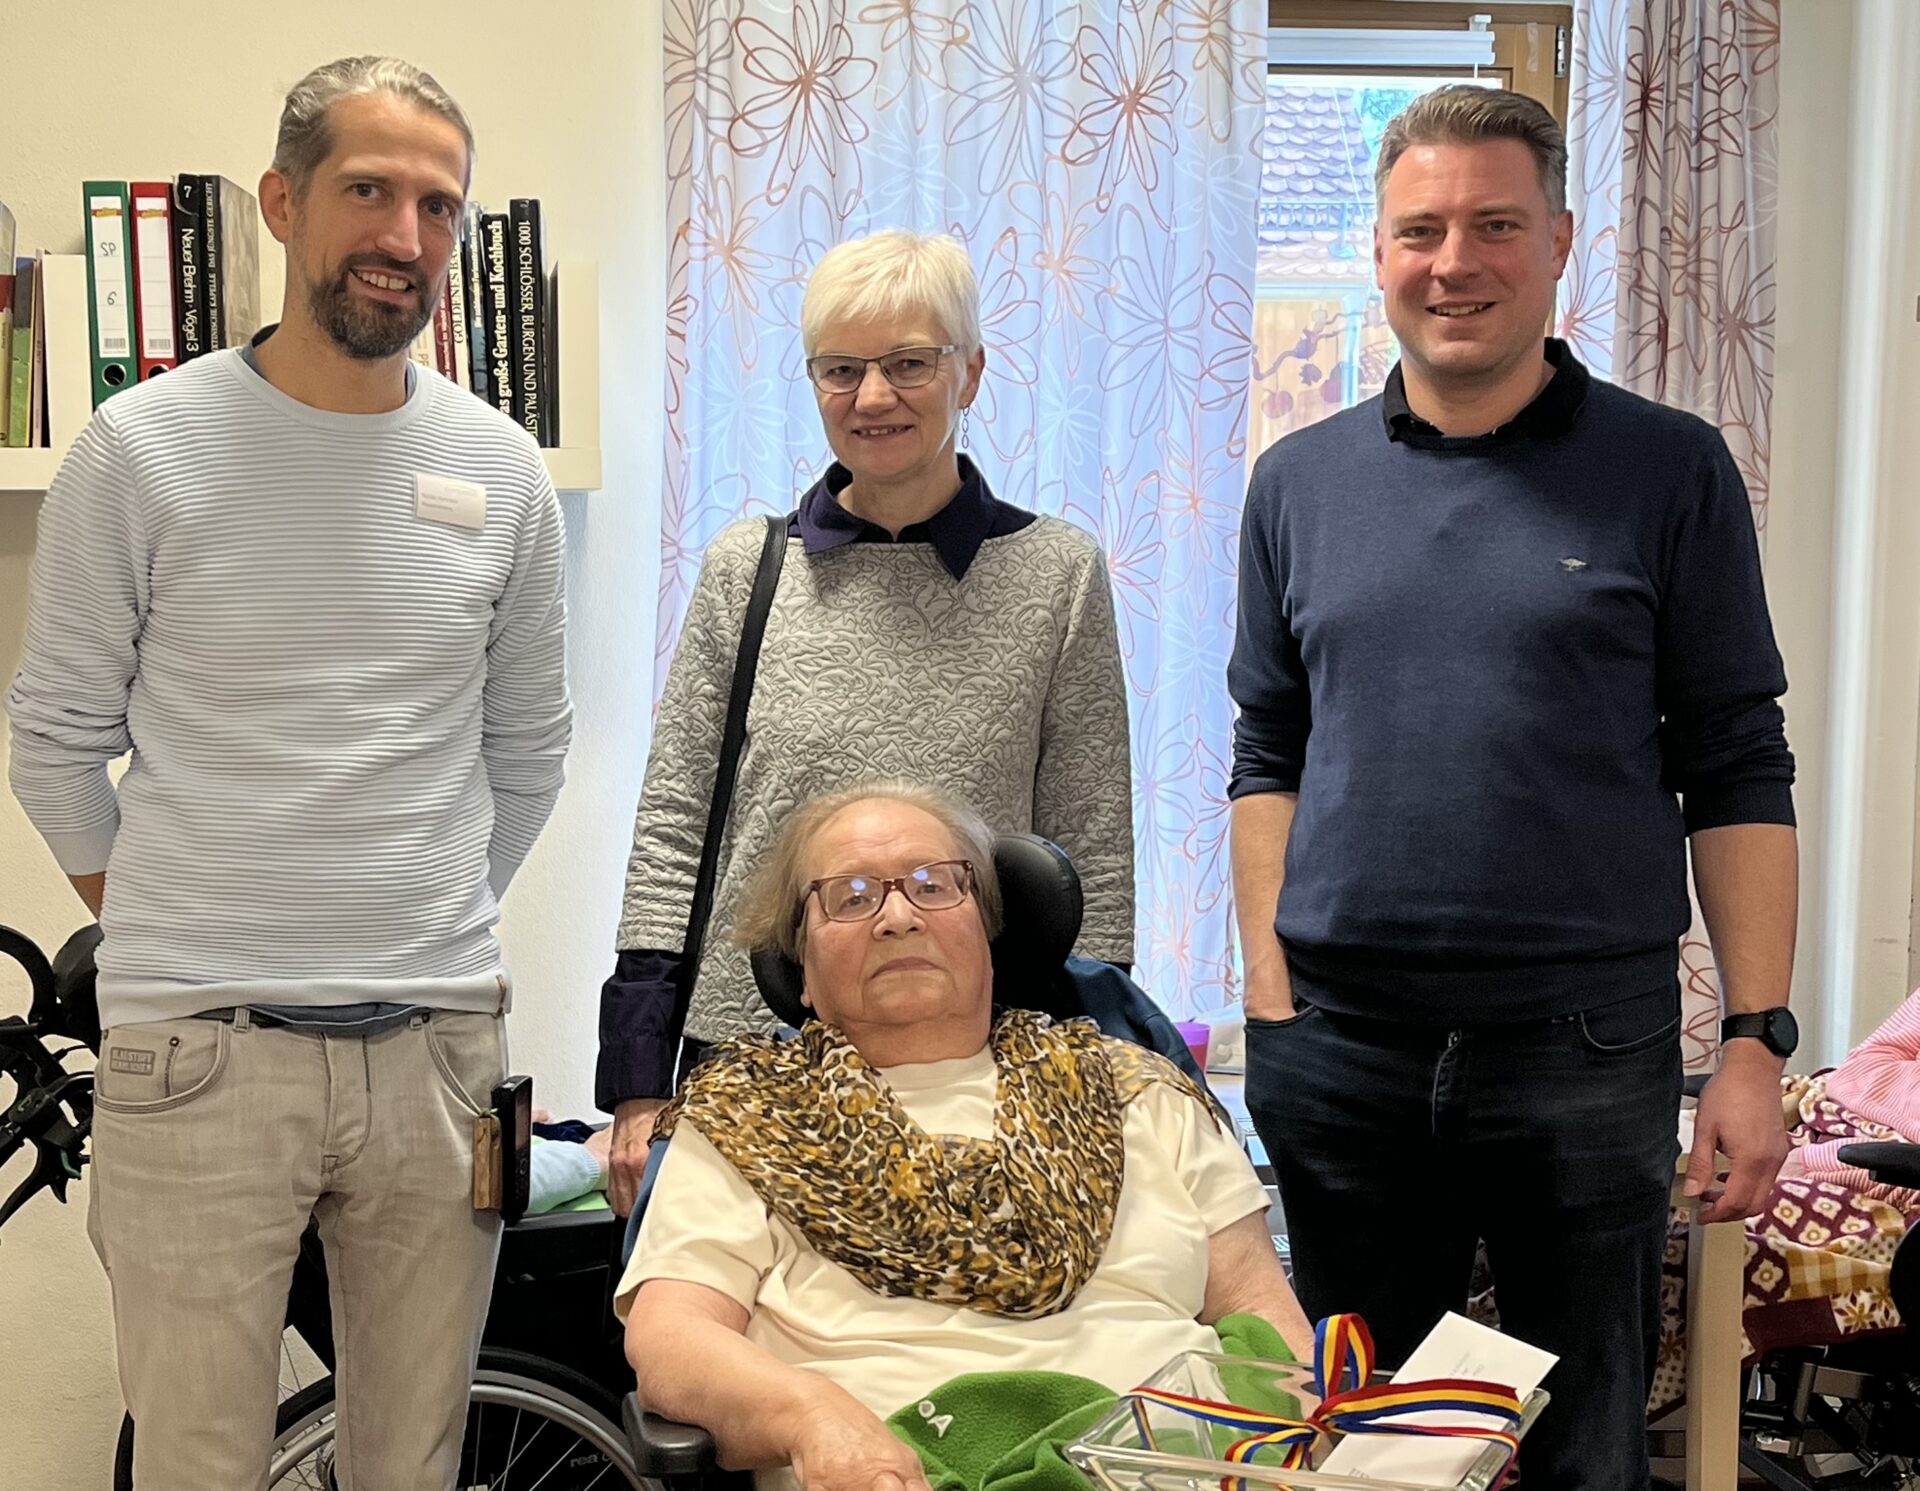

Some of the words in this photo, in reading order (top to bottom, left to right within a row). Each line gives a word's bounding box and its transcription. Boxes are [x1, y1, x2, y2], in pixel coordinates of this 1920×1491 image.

[183, 184, 192, 199] 7
[181, 228, 195, 265] Neuer
[518, 220, 532, 245] 1000
[207, 253, 216, 268] DAS
[488, 220, 505, 283] Kochbuch
[184, 265, 197, 303] Brehm
[208, 273, 218, 307] KAPELLE
[490, 284, 506, 309] und
[519, 247, 537, 312] SCHLÖSSER,
[183, 308, 198, 341] Vögel
[450, 272, 464, 344] GOLDENES
[186, 342, 199, 352] 3
[492, 310, 508, 358] Garten-
[521, 315, 536, 362] BURGEN
[493, 360, 512, 398] große
[523, 364, 538, 391] UND
[498, 399, 510, 414] as
